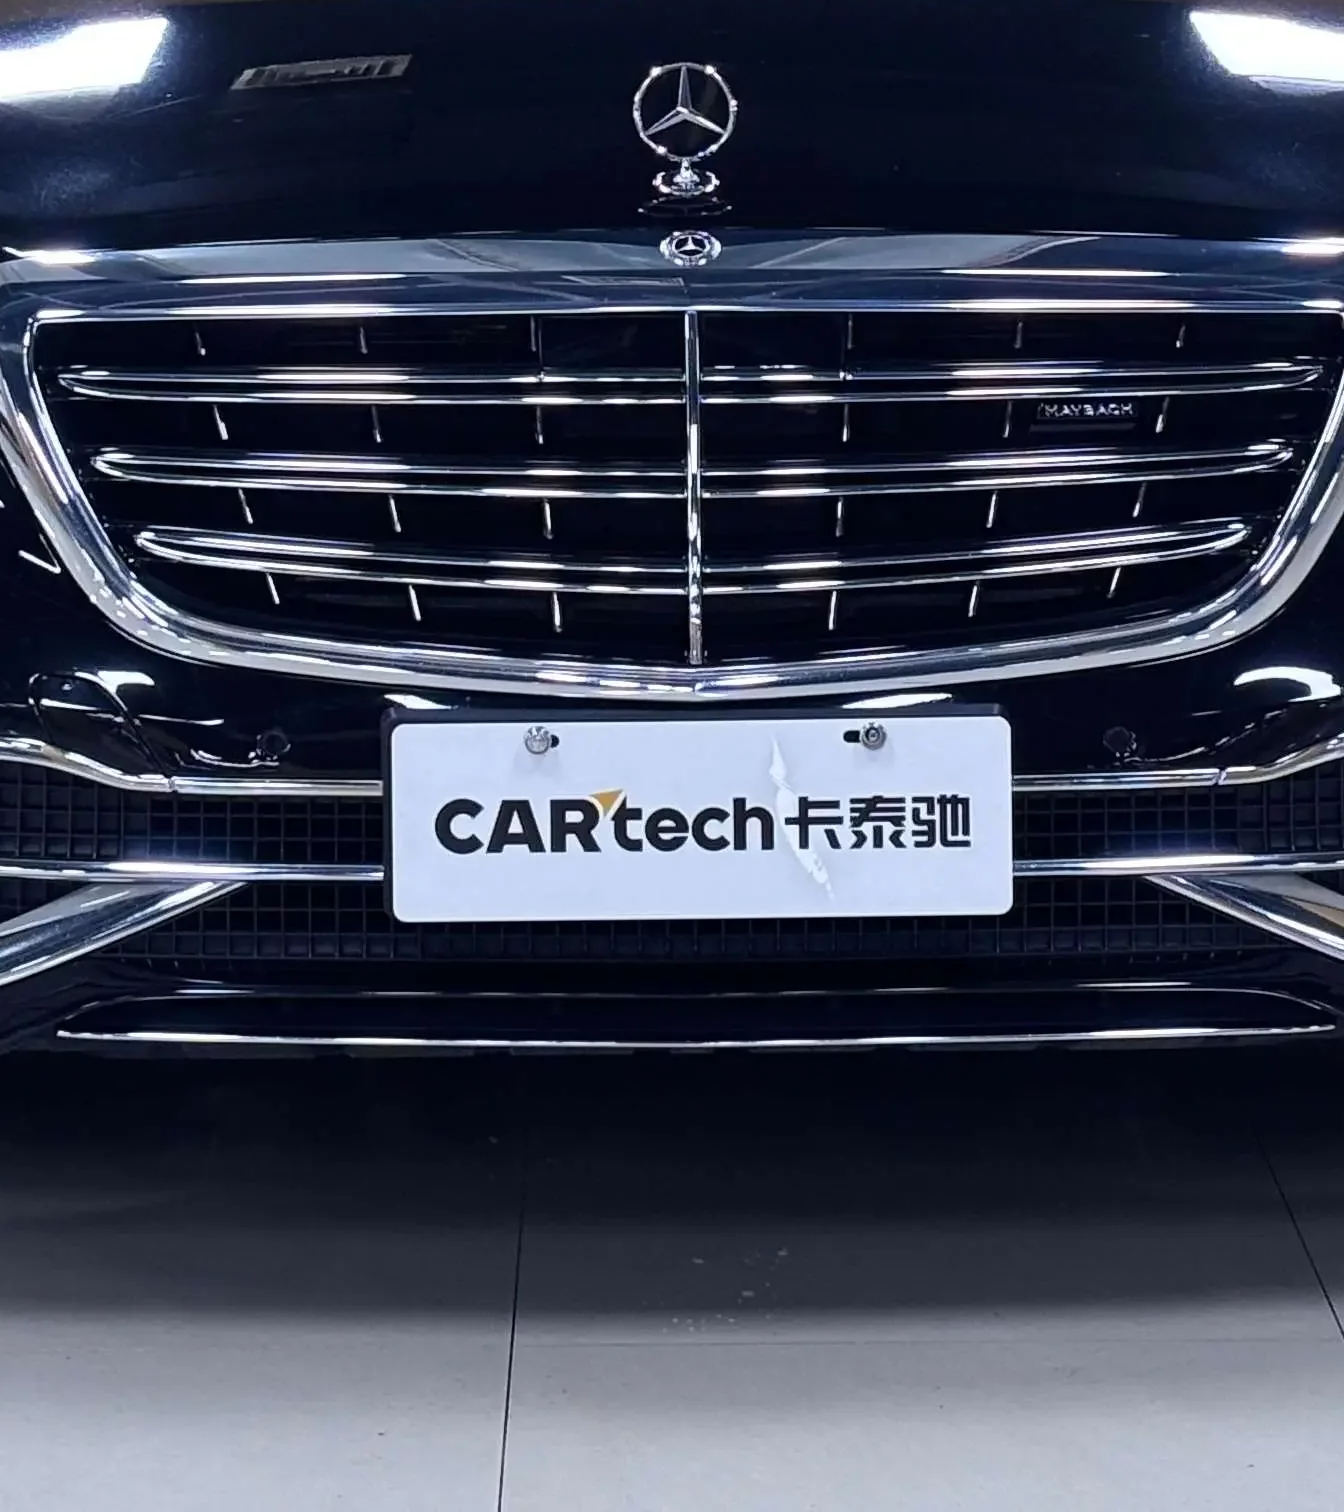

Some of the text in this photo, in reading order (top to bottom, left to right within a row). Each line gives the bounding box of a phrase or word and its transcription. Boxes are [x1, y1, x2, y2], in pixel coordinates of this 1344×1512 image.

[1044, 402, 1133, 417] MAYBACH
[434, 788, 972, 854] CARtech 卡泰驰
